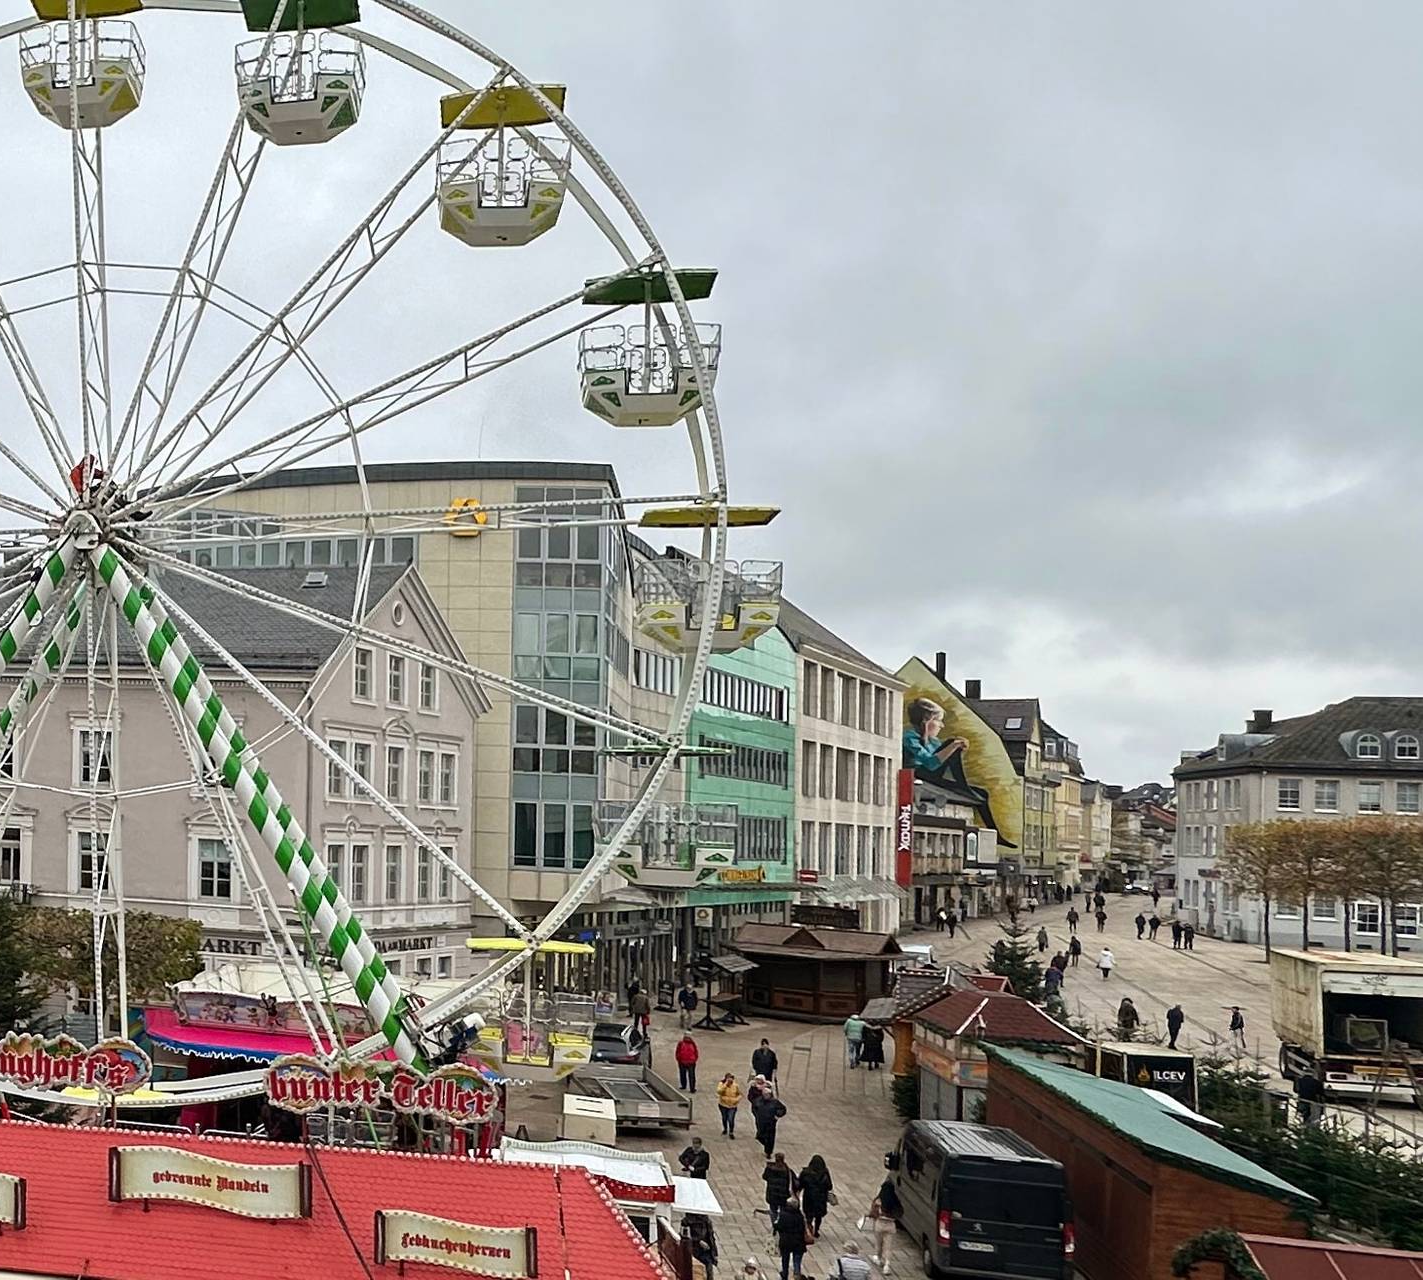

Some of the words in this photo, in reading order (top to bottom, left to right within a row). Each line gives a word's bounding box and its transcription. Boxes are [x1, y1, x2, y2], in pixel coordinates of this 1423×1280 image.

[199, 938, 261, 956] ARKT
[398, 937, 433, 952] MARKT
[269, 1070, 379, 1103] bunter
[393, 1074, 493, 1117] Teller
[152, 1170, 212, 1188] gebrannte
[216, 1175, 269, 1194] Mandeln
[401, 1232, 511, 1259] Lebkuchenherzen
